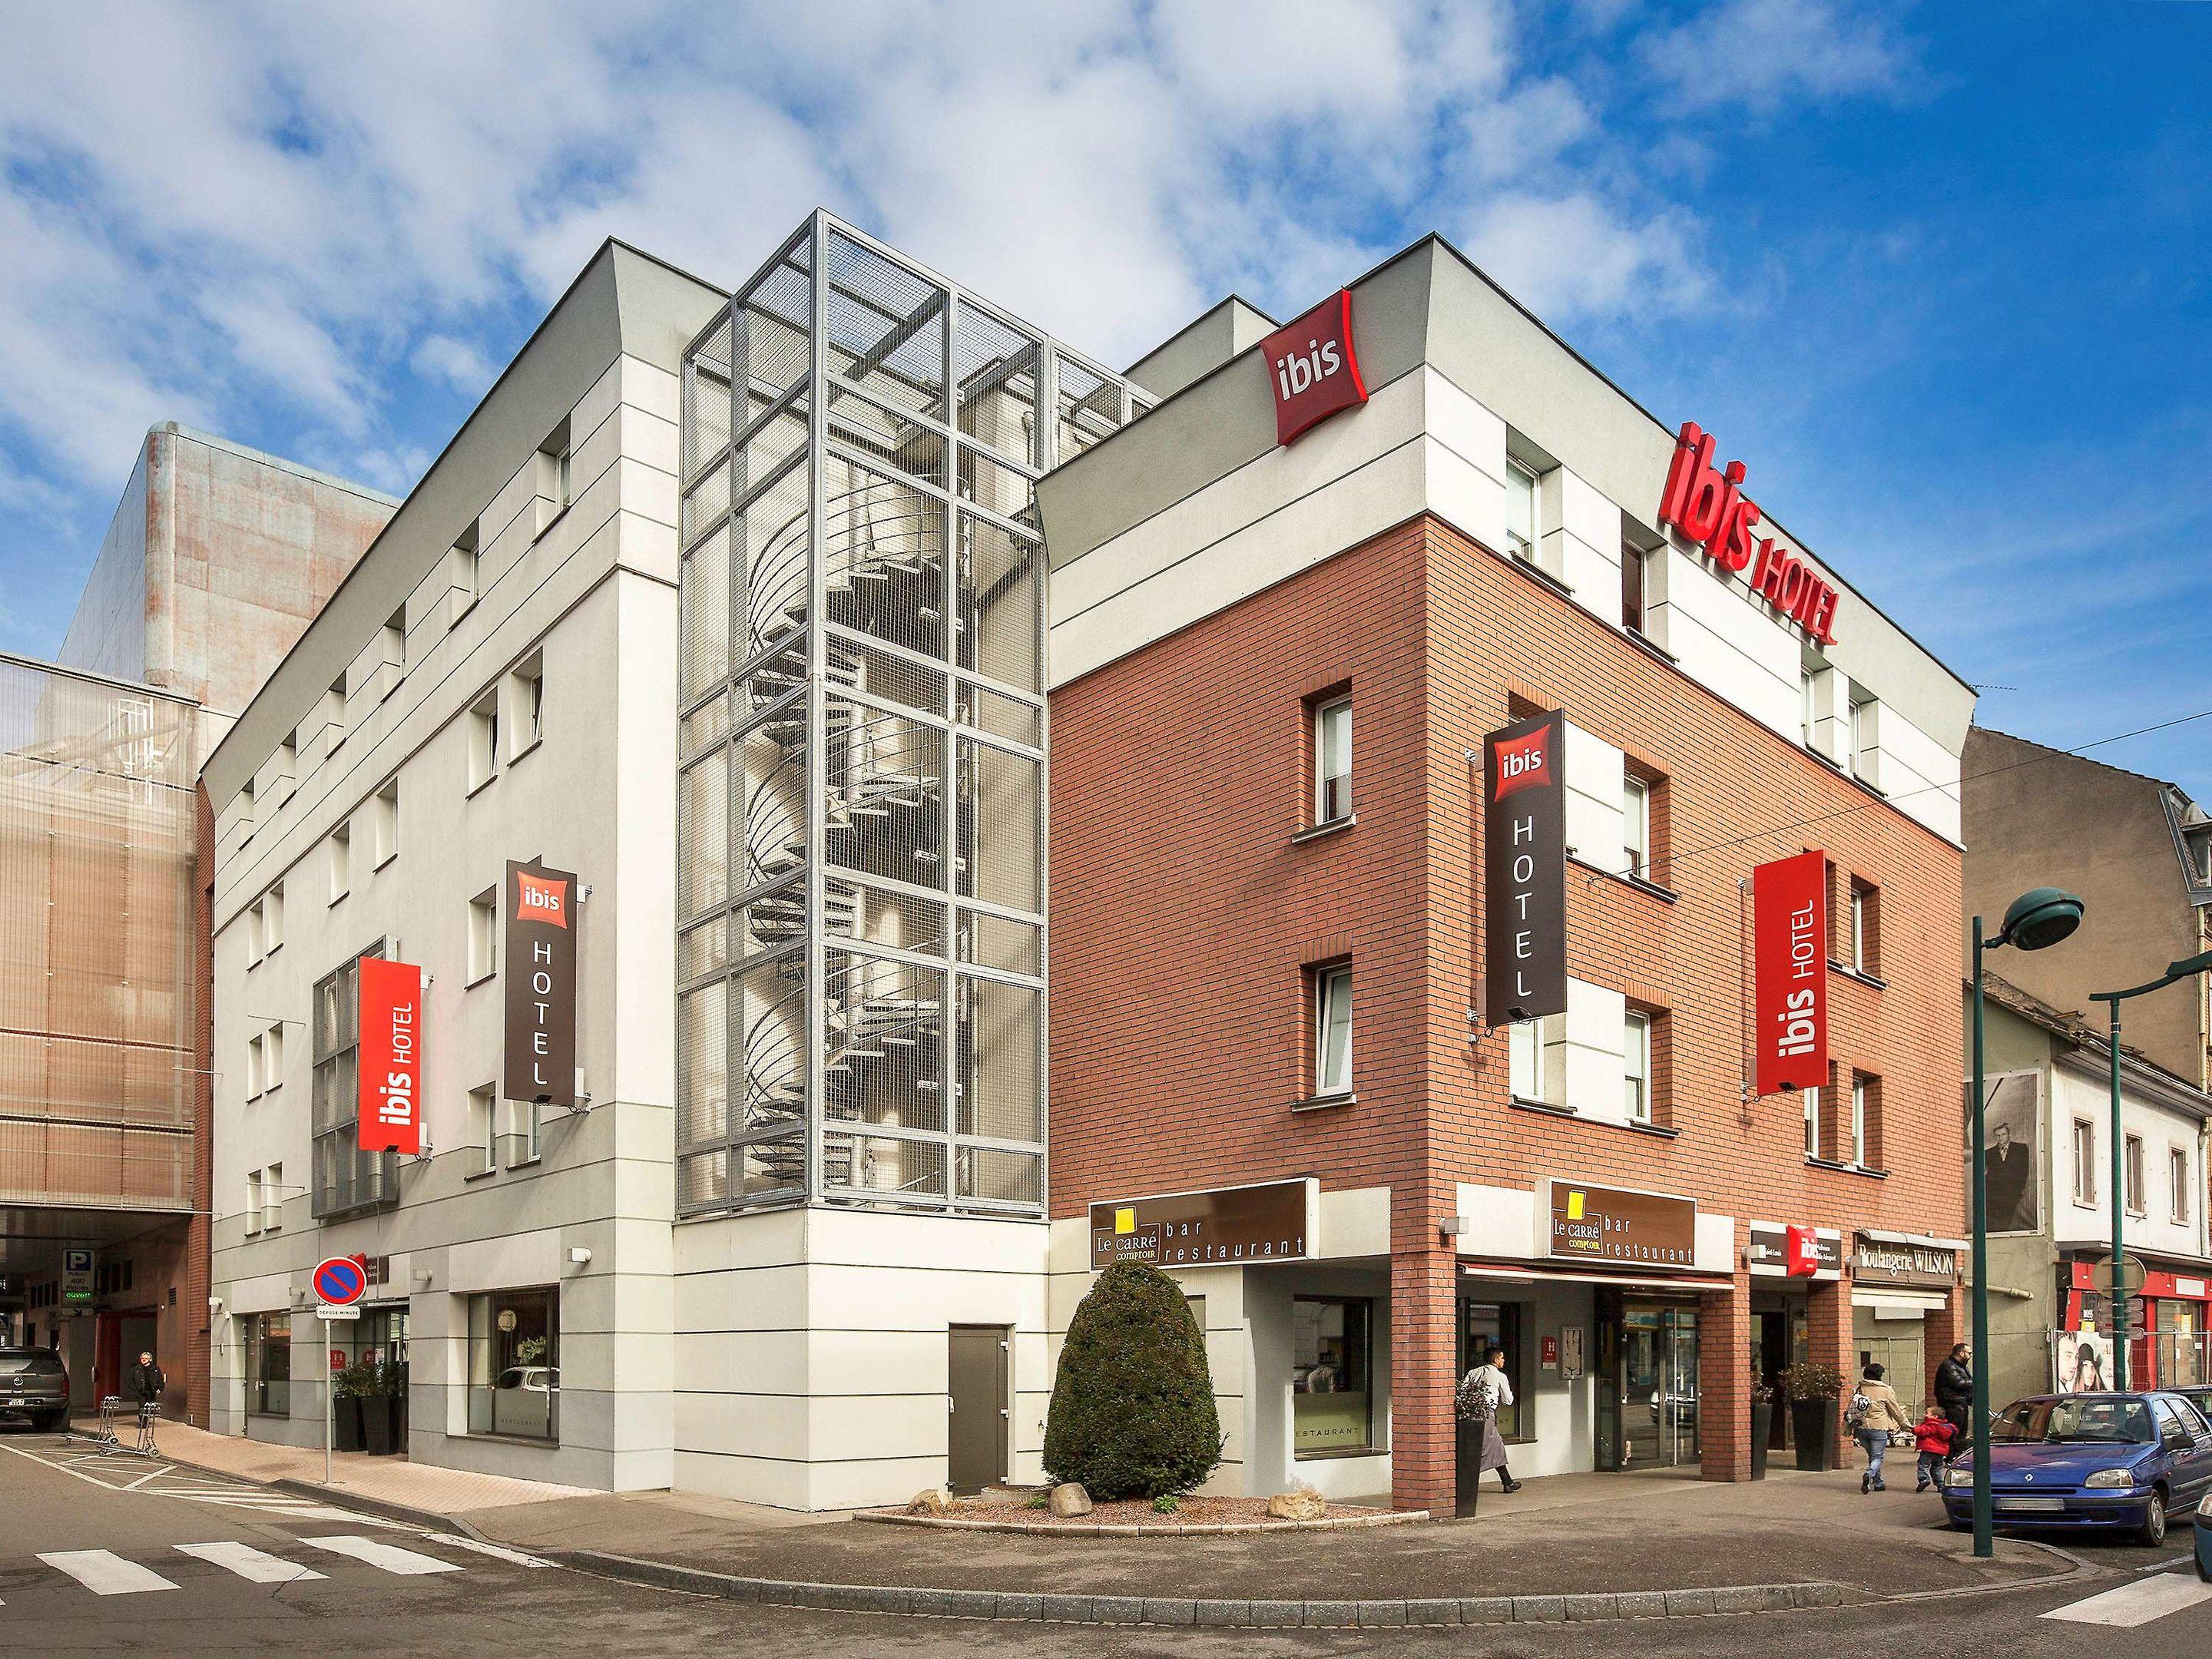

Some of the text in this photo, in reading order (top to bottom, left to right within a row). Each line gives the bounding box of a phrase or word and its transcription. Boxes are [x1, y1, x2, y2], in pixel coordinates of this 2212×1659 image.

[1277, 339, 1341, 401] ibis
[1658, 421, 1839, 645] ibis HOTEL
[1502, 748, 1542, 779] ibis
[525, 886, 561, 911] ibis
[1513, 814, 1534, 997] HOTEL
[1779, 899, 1816, 1058] ibis HOTEL
[532, 941, 552, 1085] HOTEL
[379, 1002, 412, 1126] ibis HOTEL
[1166, 1221, 1201, 1237] bar
[1554, 1218, 1565, 1235] Le
[1604, 1214, 1630, 1232] bar
[1097, 1237, 1111, 1252] Le
[1165, 1236, 1303, 1262] restaurant
[1605, 1242, 1693, 1263] restaurant
[71, 1253, 87, 1269] P
[1858, 1243, 1953, 1277] Boulangerie WILSON
[1295, 1427, 1359, 1437] ESTAURANT
